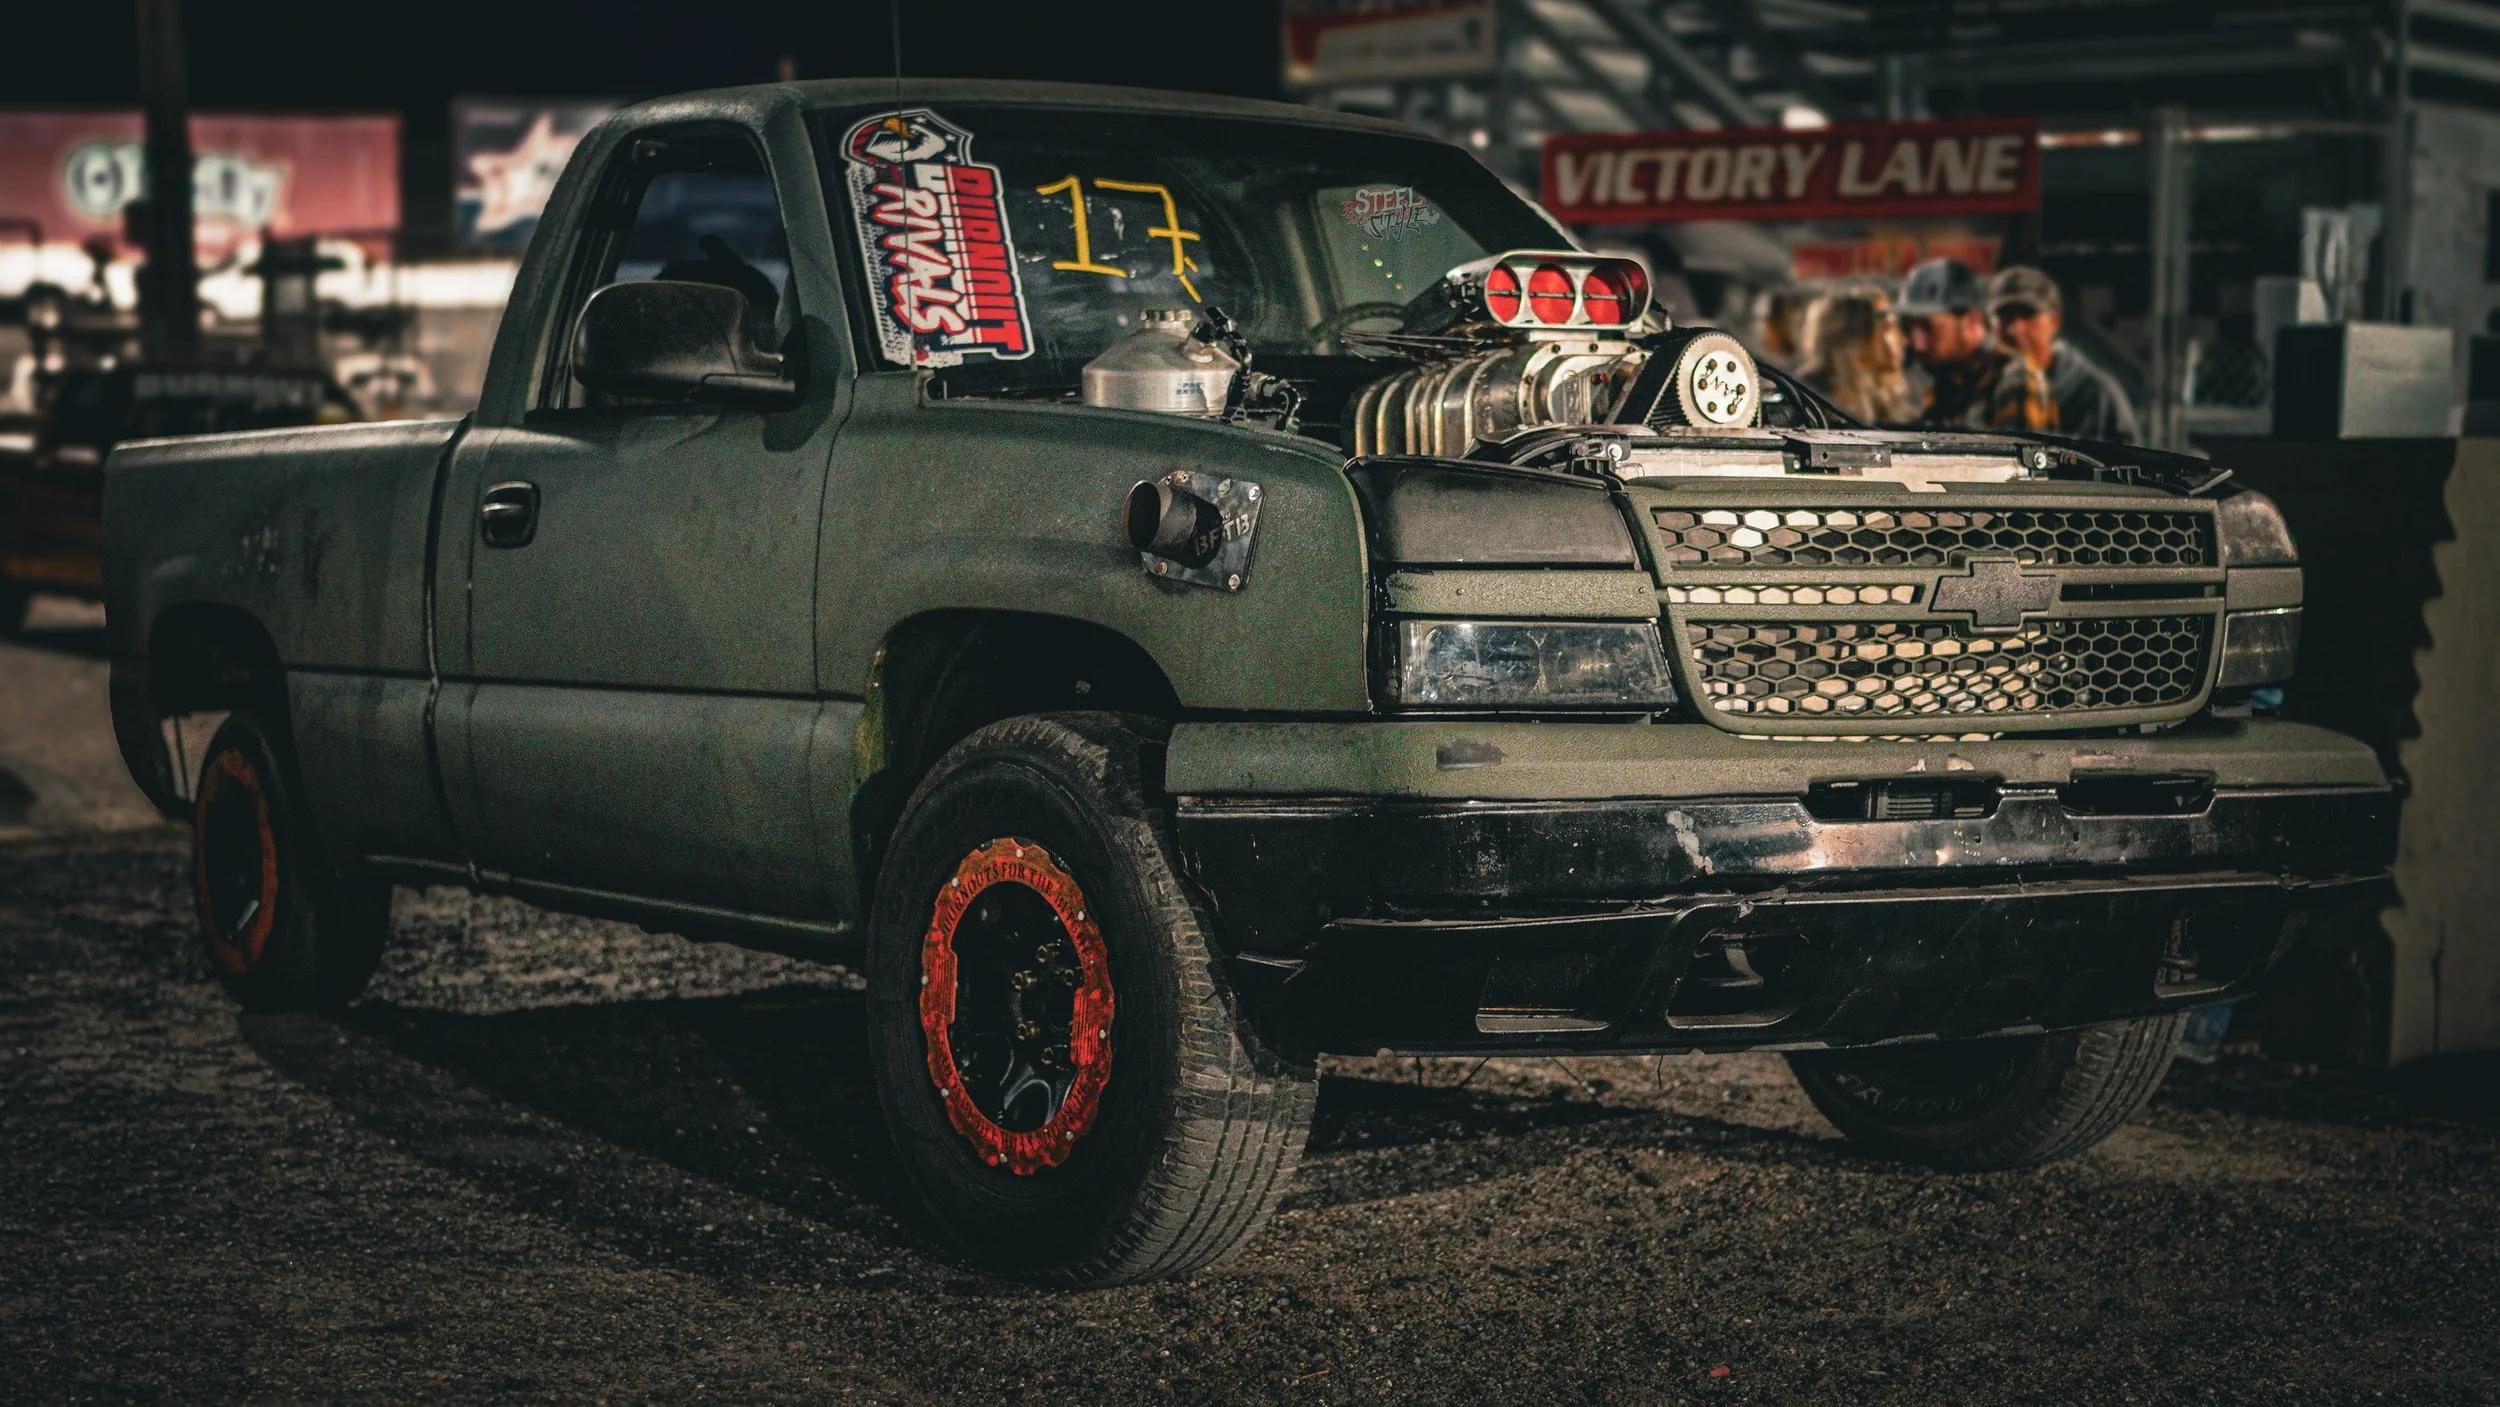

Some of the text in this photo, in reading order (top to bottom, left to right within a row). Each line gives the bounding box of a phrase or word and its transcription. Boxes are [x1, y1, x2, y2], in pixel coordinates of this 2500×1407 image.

[1355, 186, 1424, 215] STEEL
[1555, 134, 2023, 205] VICTORY LANE
[870, 182, 968, 334] RIVALS
[913, 163, 1025, 351] BURNOUT
[1035, 174, 1202, 296] 17
[1369, 204, 1430, 241] STYLE
[1000, 861, 1026, 879] FOR
[1029, 868, 1054, 898] THE
